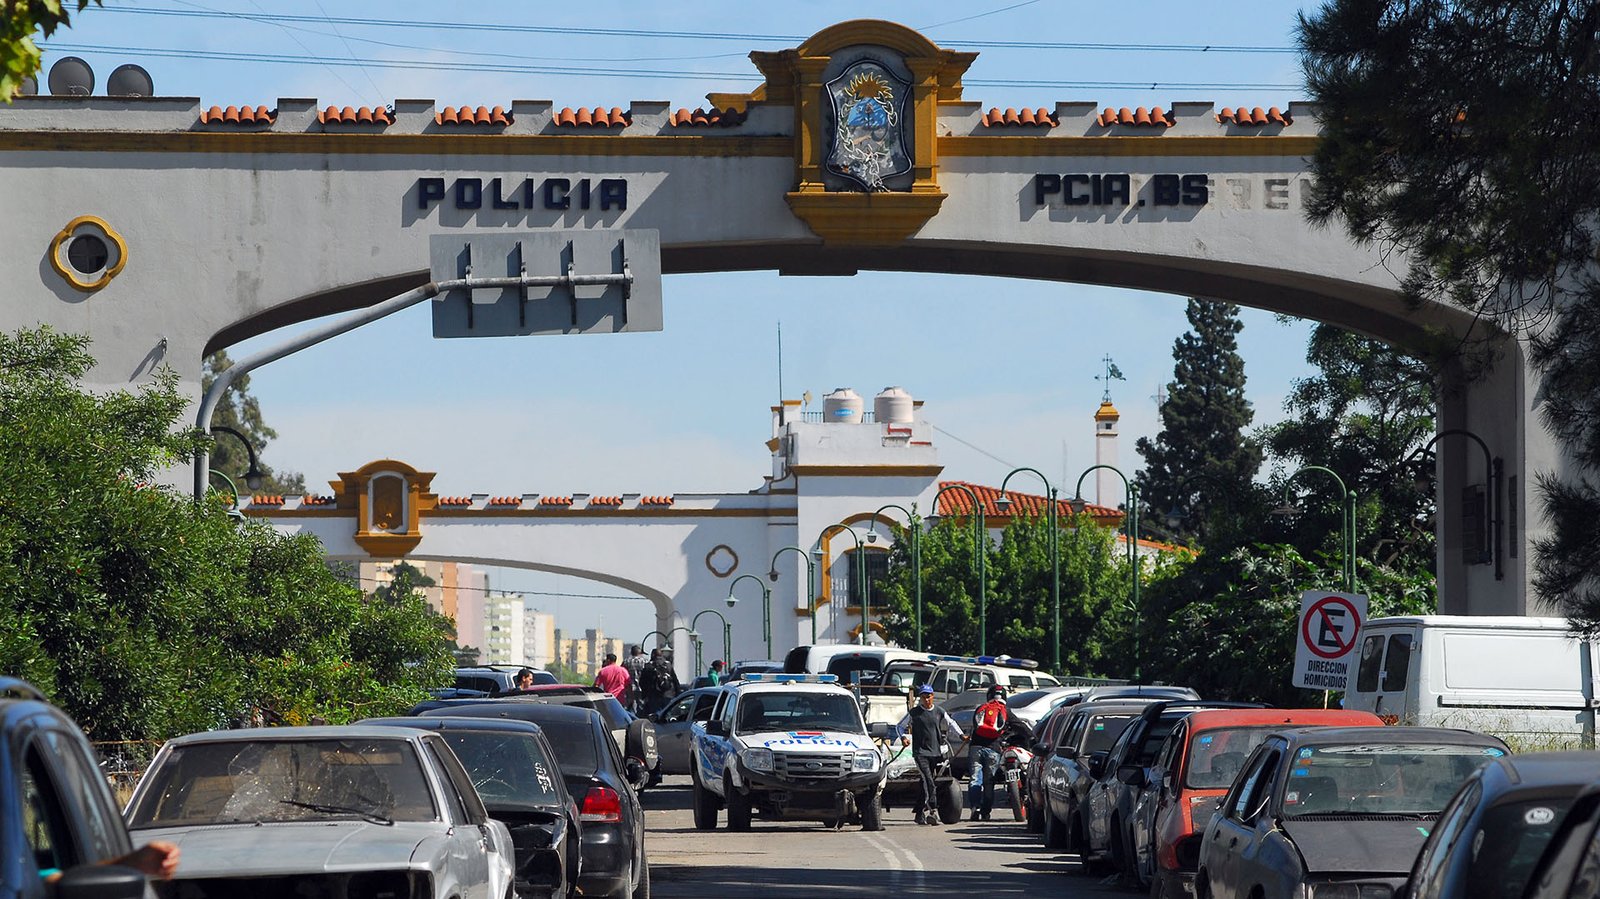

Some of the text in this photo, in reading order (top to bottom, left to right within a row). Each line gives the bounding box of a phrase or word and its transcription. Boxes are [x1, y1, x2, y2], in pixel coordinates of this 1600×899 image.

[418, 178, 628, 211] POLICIA
[1308, 660, 1348, 675] DIRECCION
[1303, 673, 1348, 689] HOMICIDIOS
[764, 739, 859, 748] POLICIA
